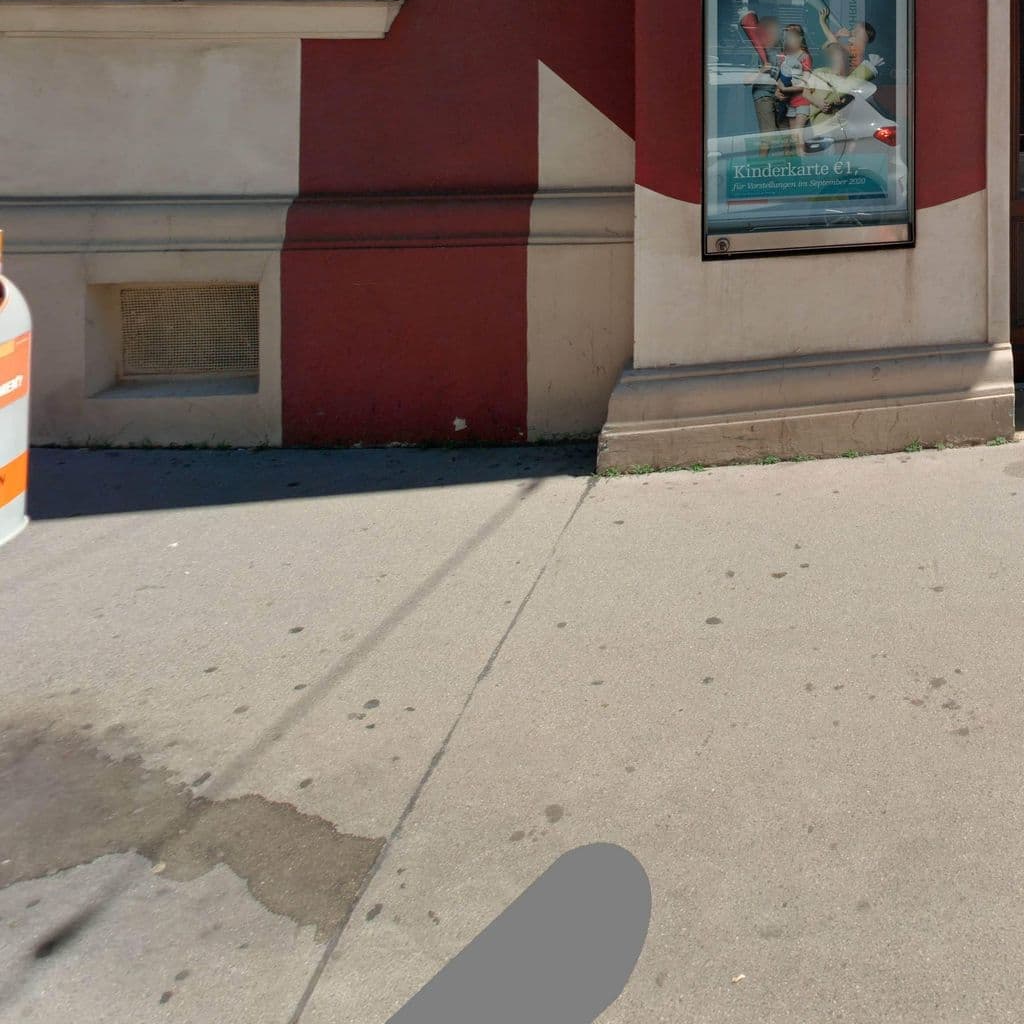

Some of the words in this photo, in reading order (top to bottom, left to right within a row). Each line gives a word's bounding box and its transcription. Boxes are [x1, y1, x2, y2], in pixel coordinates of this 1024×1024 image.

[733, 162, 829, 178] Kinderkarte
[732, 182, 746, 192] für
[747, 181, 796, 190] Vorstellungen
[809, 177, 848, 189] September
